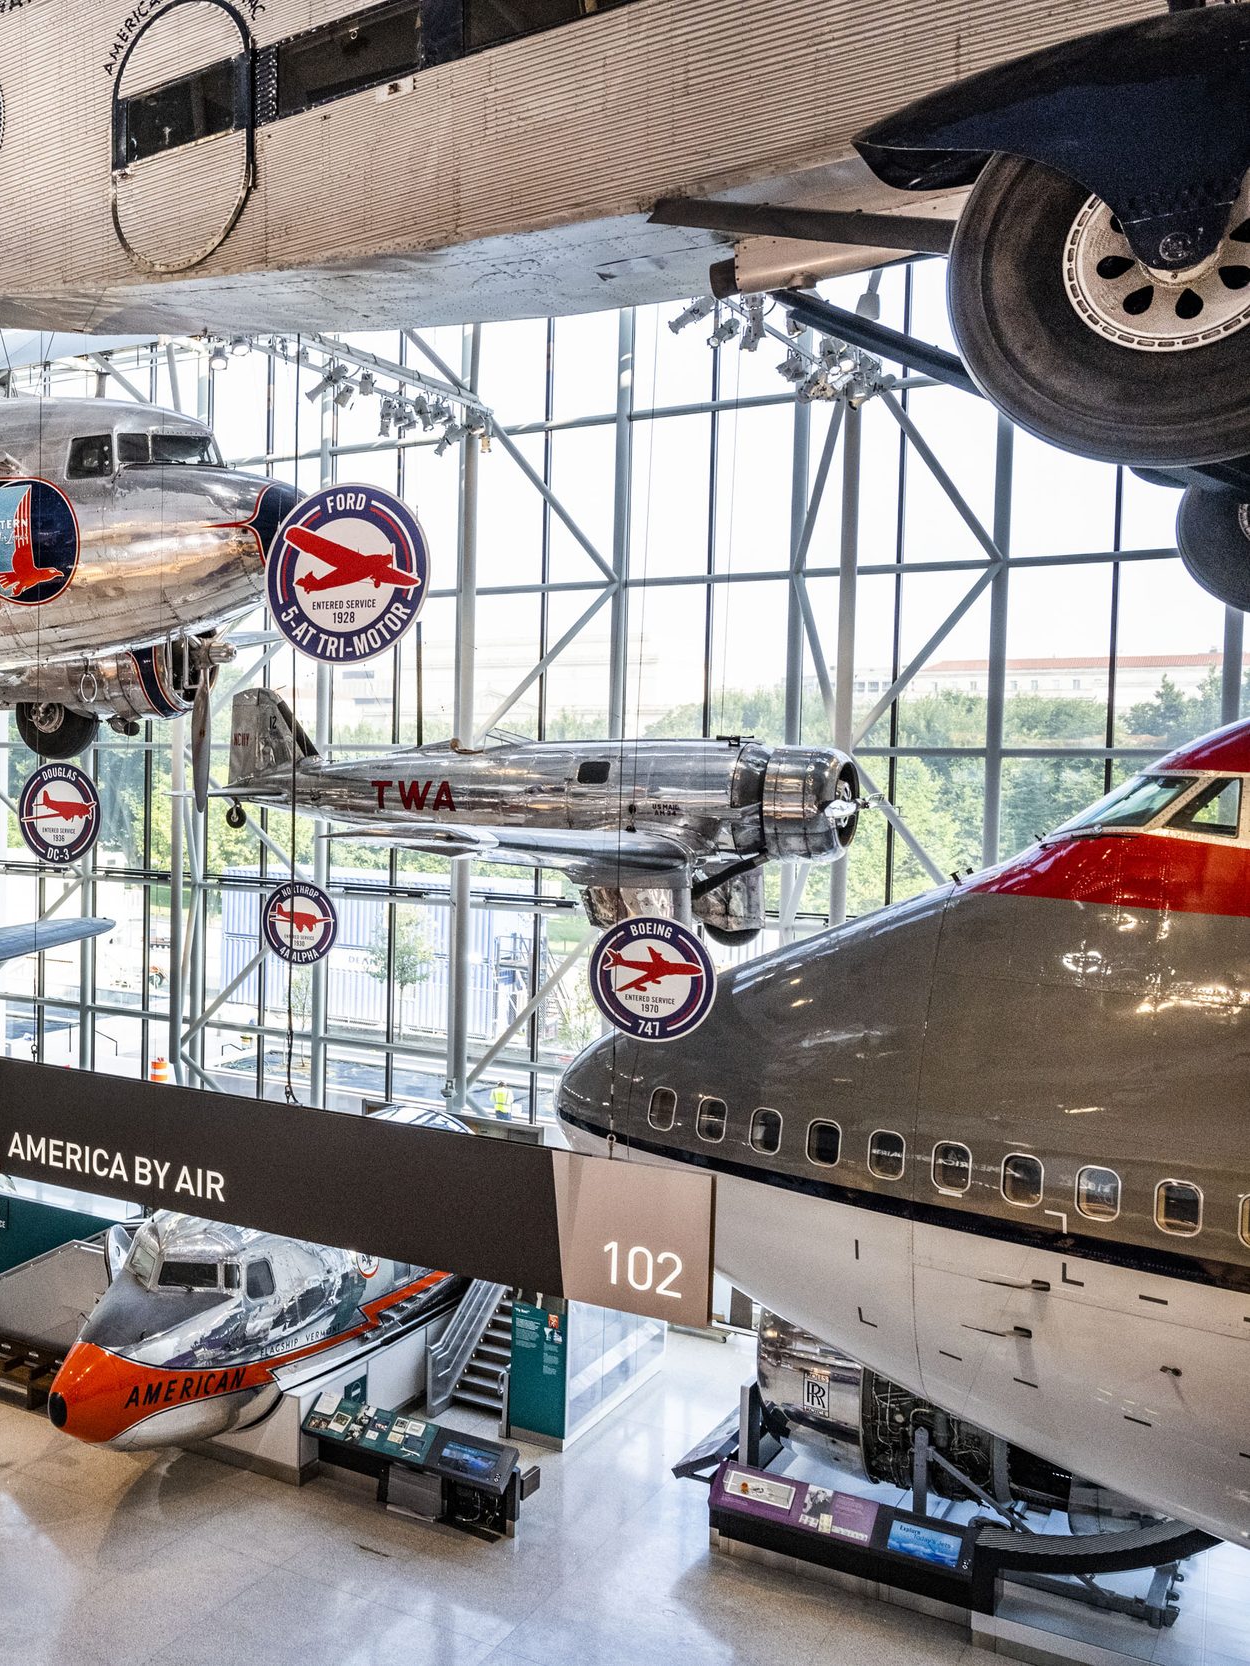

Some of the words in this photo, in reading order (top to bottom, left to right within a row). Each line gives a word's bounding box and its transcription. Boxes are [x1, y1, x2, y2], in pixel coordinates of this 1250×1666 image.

[326, 493, 366, 513] FORD
[312, 601, 344, 610] ENTERED
[345, 599, 376, 609] SERVICE
[333, 612, 355, 623] 1928
[281, 605, 316, 646] 5-AT
[316, 602, 411, 658] TRI-MOTOR
[42, 767, 77, 781] DOUGLAS
[371, 780, 456, 812] TWA
[47, 847, 69, 860] DC-3
[630, 922, 673, 938] BOEING
[280, 946, 290, 958] 4A
[292, 948, 319, 962] ALPHA
[625, 994, 650, 1003] ENTERED
[651, 996, 675, 1005] SERVICE
[641, 1004, 659, 1013] 1970
[638, 1020, 660, 1036] 747
[7, 1132, 128, 1182] AMERICA
[134, 1156, 170, 1189] BY
[175, 1166, 225, 1202] AIR
[604, 1241, 682, 1299] 102
[260, 1338, 299, 1358] FLAGSHIP
[305, 1323, 341, 1342] VERMONT
[124, 1368, 246, 1409] AMERICAN
[807, 1381, 825, 1409] RR
[900, 1525, 920, 1536] Explore
